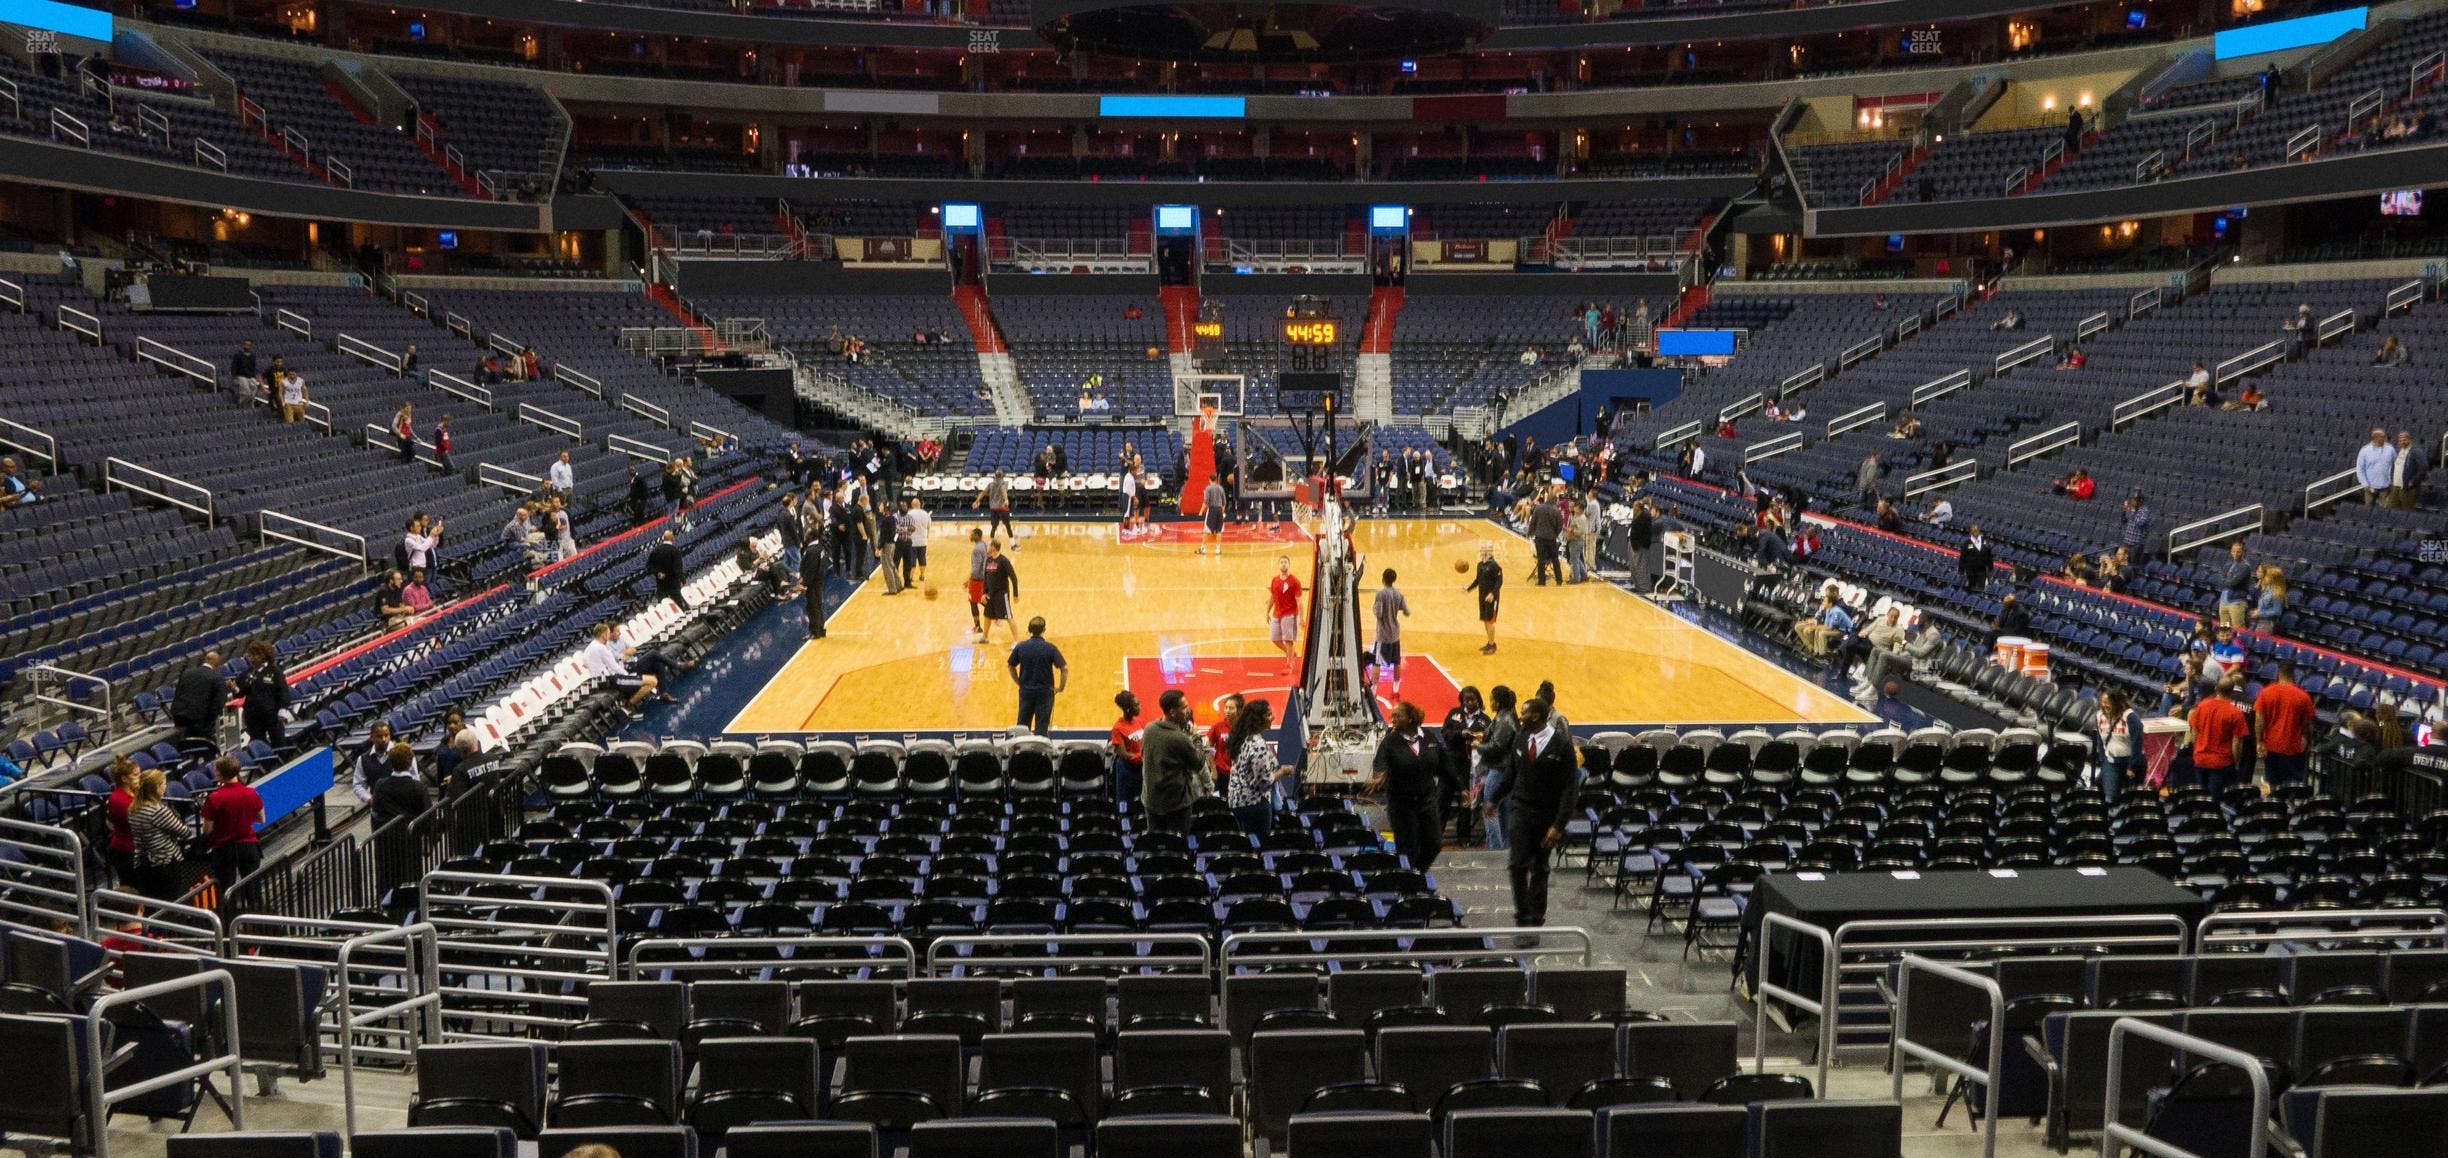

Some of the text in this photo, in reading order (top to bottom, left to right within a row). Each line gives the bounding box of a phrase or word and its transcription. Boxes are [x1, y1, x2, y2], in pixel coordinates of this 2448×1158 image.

[1195, 324, 1221, 336] 44:59
[1286, 323, 1335, 343] 44:59
[2413, 752, 2434, 768] EVENT
[467, 764, 486, 779] EVENT
